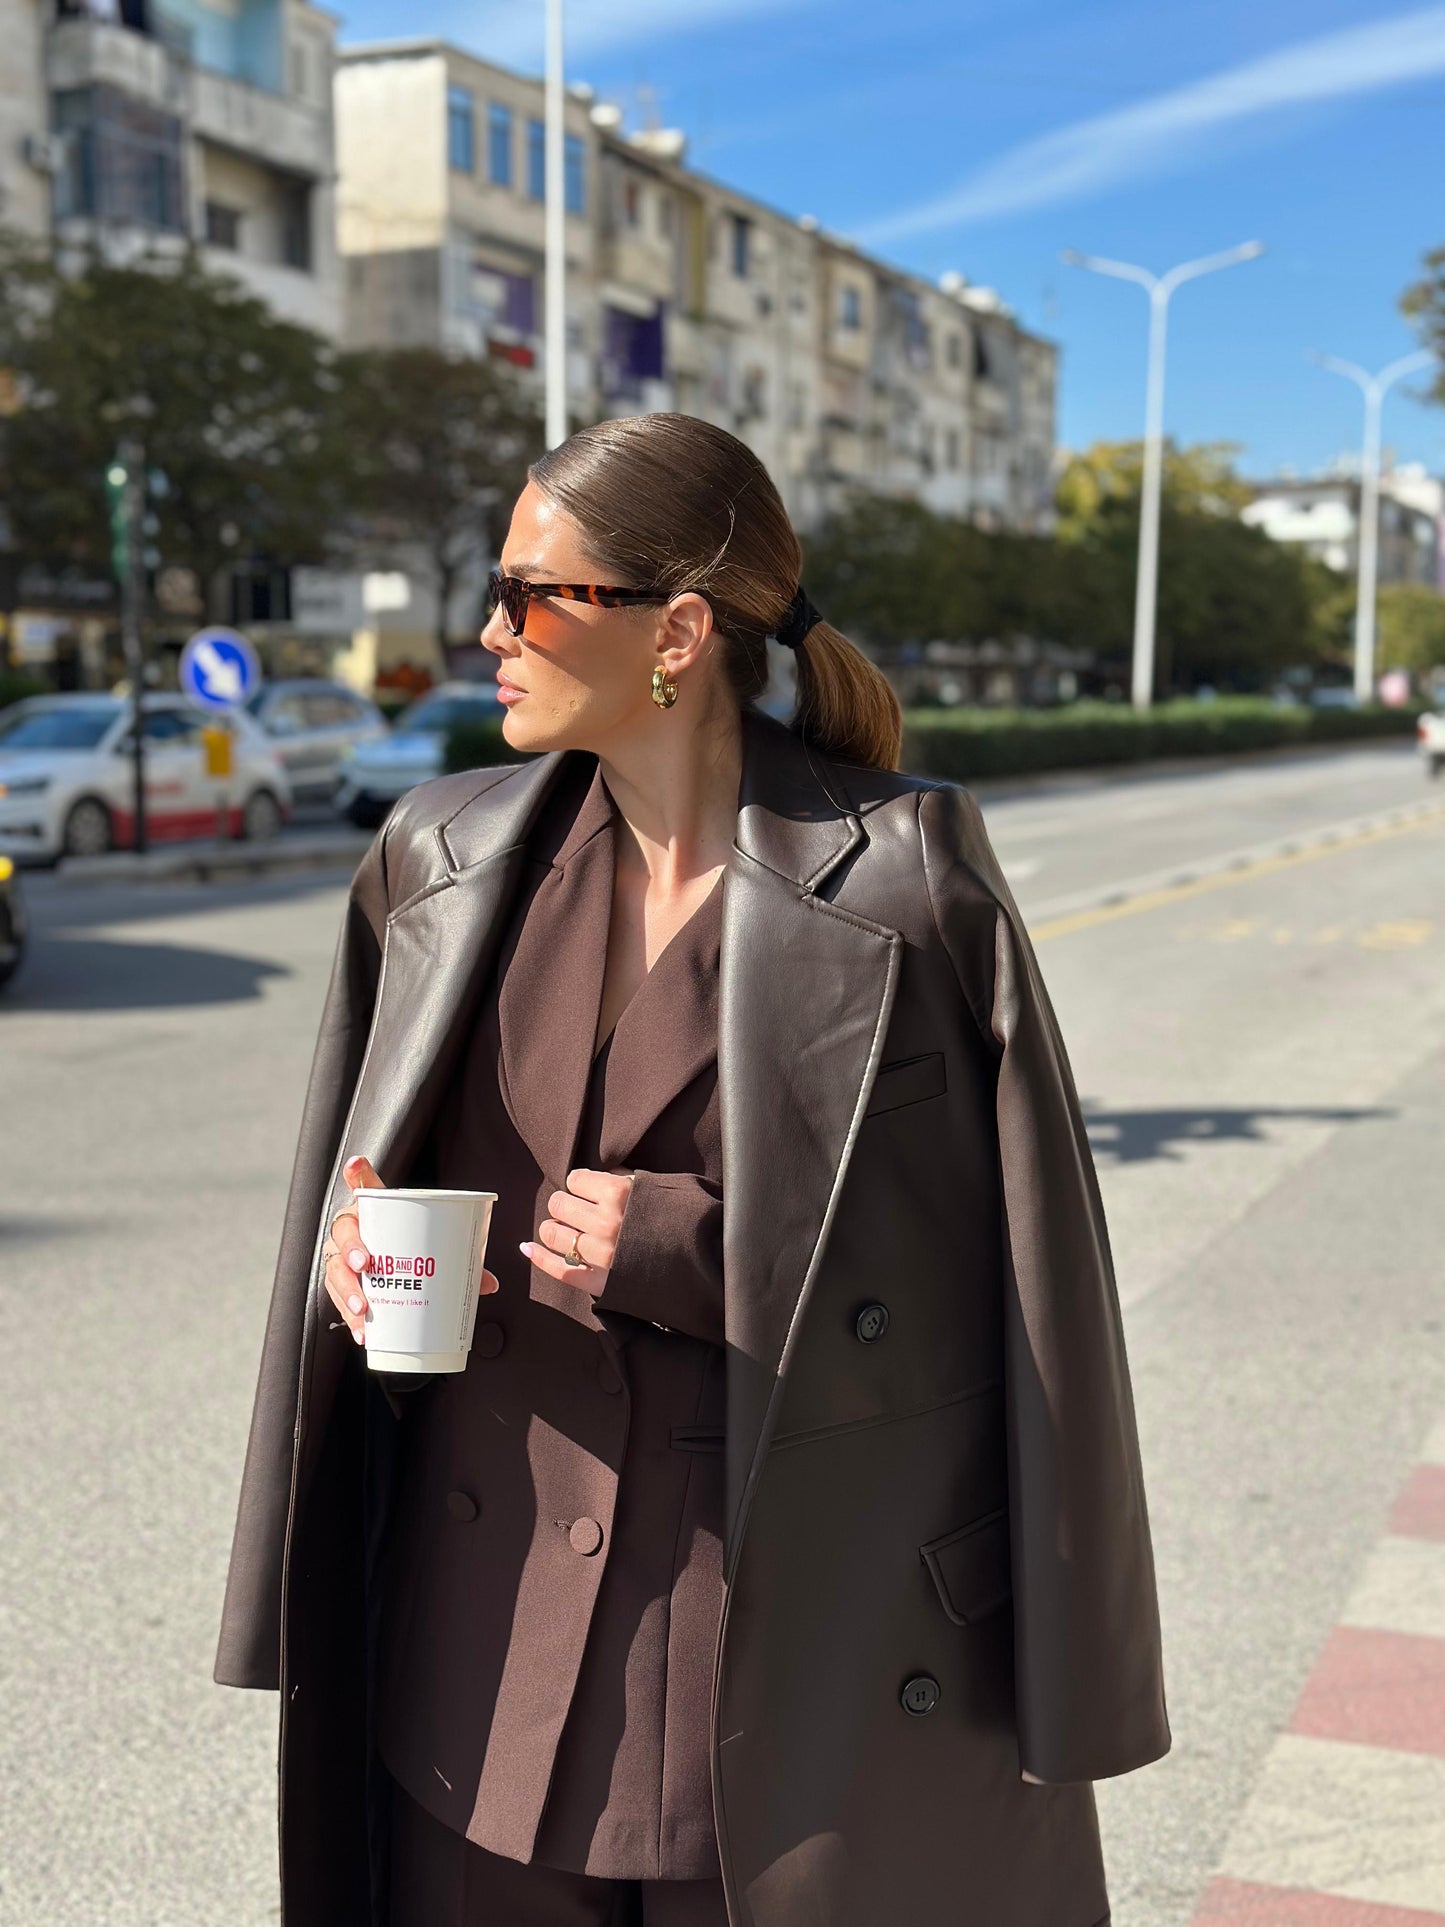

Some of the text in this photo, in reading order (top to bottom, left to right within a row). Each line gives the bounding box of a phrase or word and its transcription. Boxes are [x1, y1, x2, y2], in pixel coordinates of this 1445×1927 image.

[366, 1255, 435, 1277] RAB AND GO
[371, 1277, 422, 1290] COFFEE
